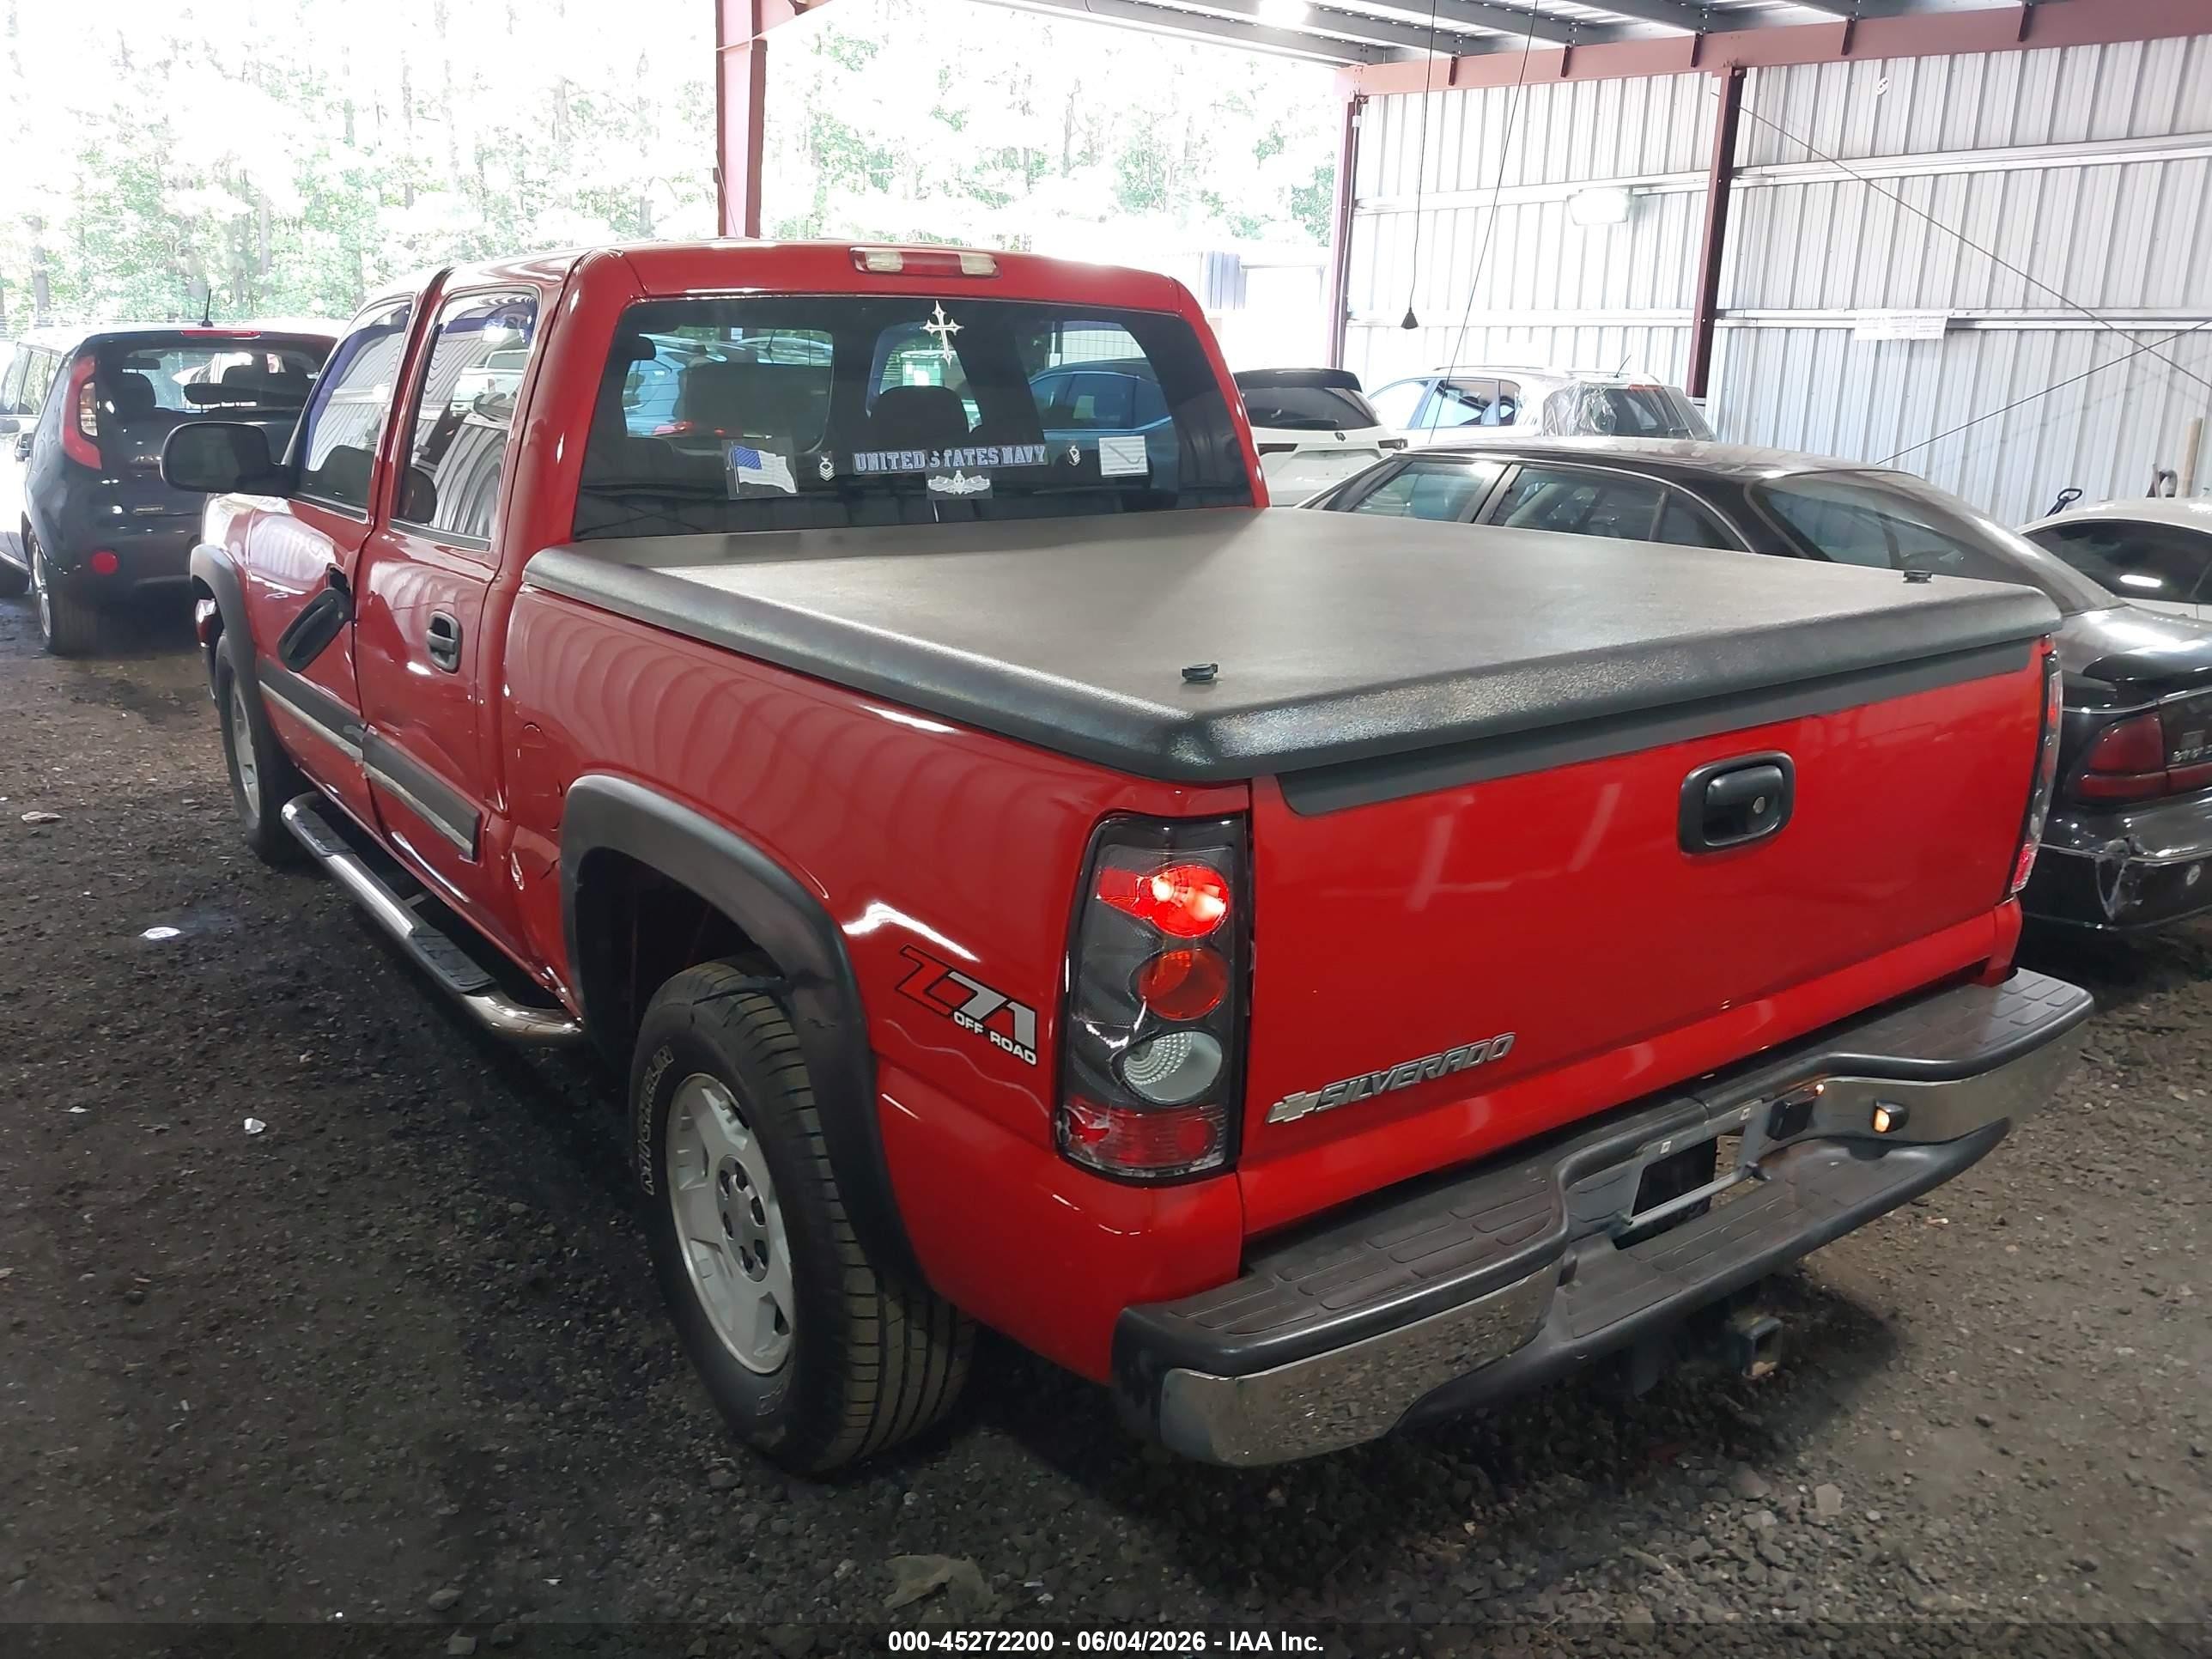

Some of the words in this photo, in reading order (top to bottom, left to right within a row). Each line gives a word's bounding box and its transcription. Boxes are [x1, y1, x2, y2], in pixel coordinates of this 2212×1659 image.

[854, 450, 926, 472] UNITED
[928, 447, 1000, 469] STATES
[1001, 444, 1046, 465] NAVY
[895, 944, 1037, 1050] Z71
[953, 1011, 984, 1034] OFF
[989, 1030, 1037, 1066] ROAD
[1314, 1032, 1516, 1113] SILVERADO
